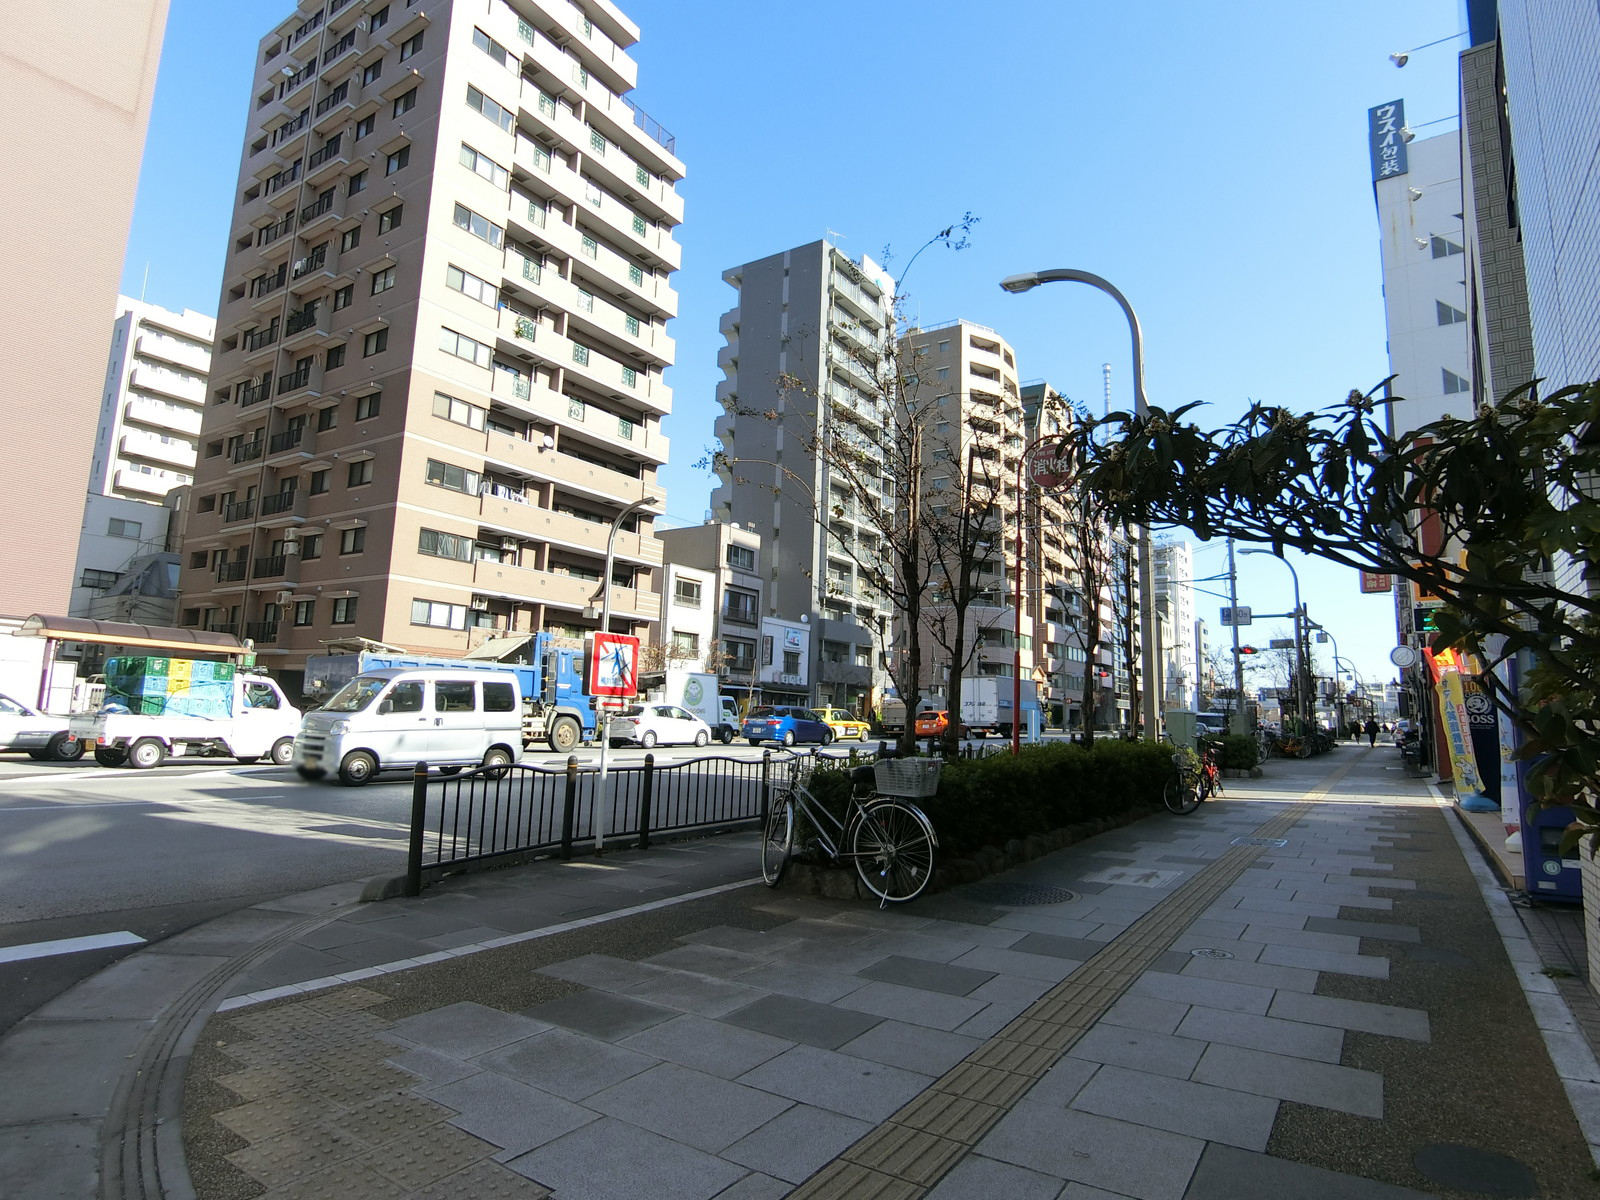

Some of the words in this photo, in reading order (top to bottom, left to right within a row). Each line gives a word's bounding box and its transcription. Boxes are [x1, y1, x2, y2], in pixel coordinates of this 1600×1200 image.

[1376, 104, 1400, 176] ウスイ包装
[1467, 714, 1495, 724] OSS
